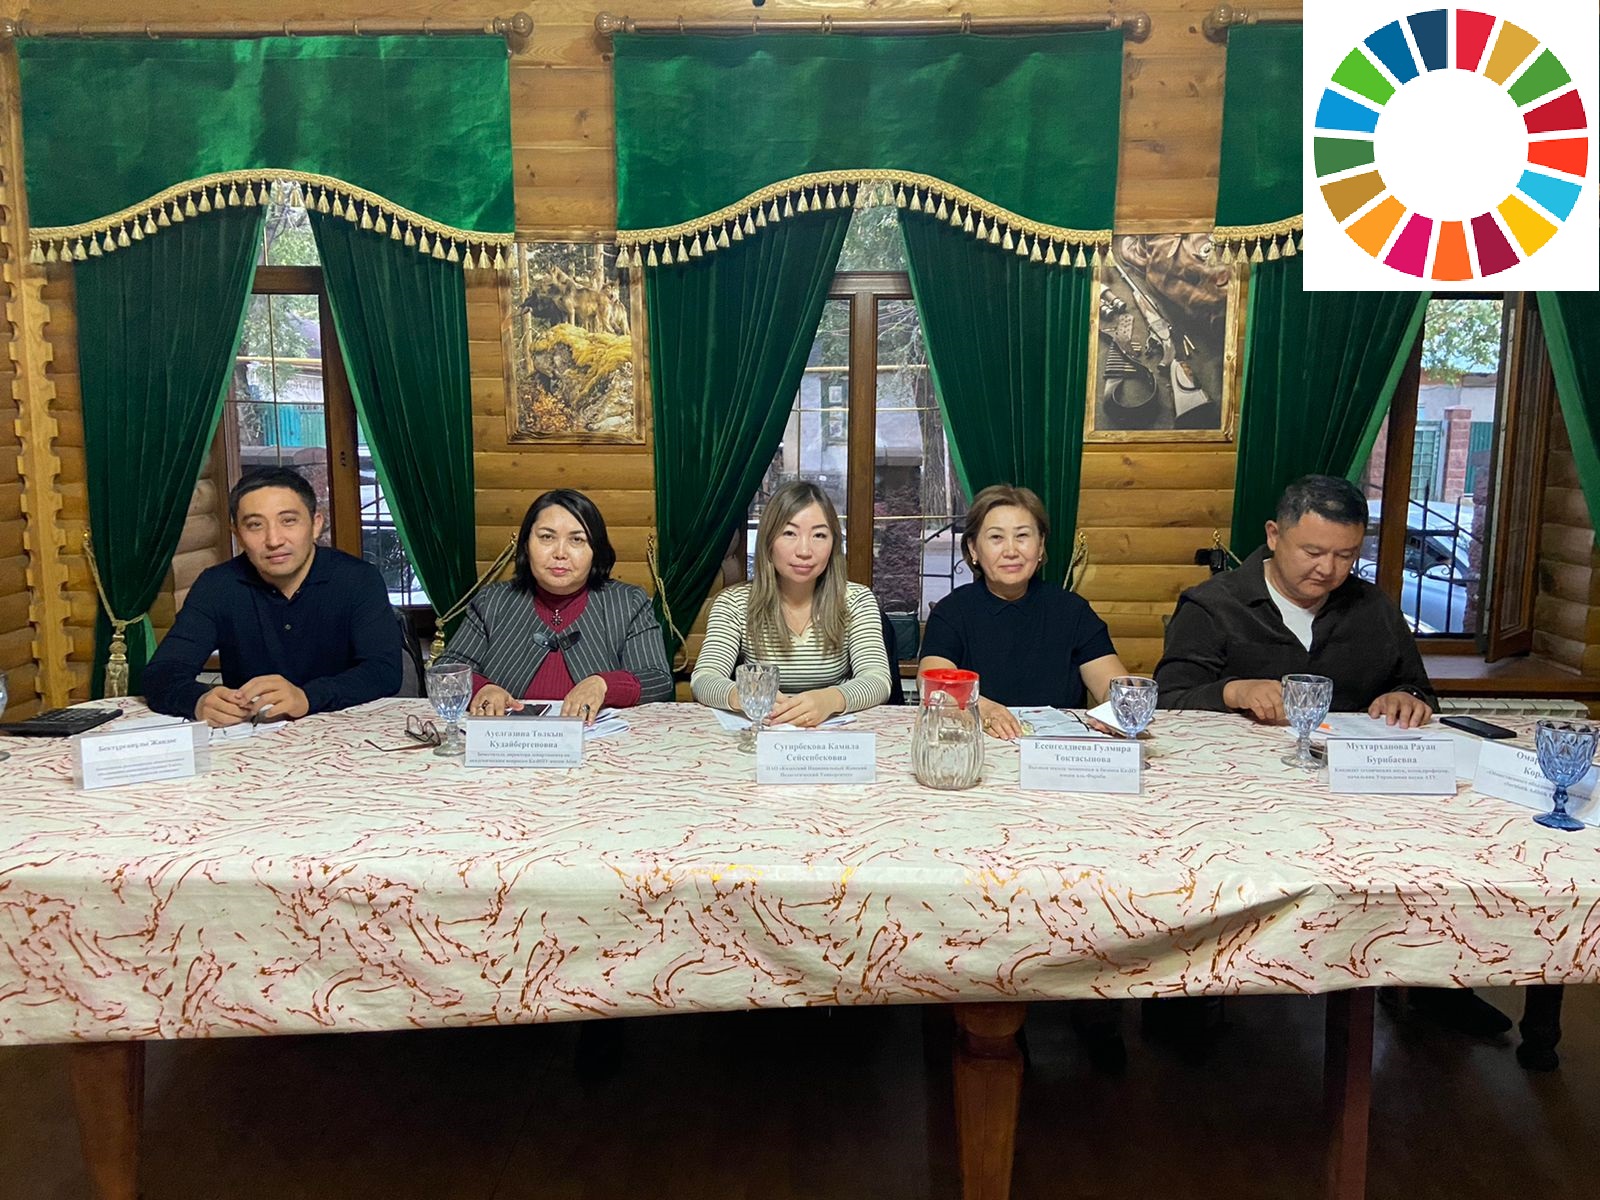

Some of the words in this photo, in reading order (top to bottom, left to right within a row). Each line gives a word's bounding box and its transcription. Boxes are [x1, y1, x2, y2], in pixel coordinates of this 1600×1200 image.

[489, 740, 558, 750] Кудайбергеновна
[774, 742, 826, 752] Сугирбекова
[828, 742, 859, 750] Камила
[1093, 743, 1132, 753] Гулмира
[1346, 742, 1409, 751] Мухтарханова
[1411, 742, 1436, 751] Рауан
[786, 753, 847, 761] Сейсенбековна
[1055, 754, 1111, 763] Токтасынова
[1366, 755, 1417, 765] Бурибаевна
[1516, 751, 1539, 764] Омар
